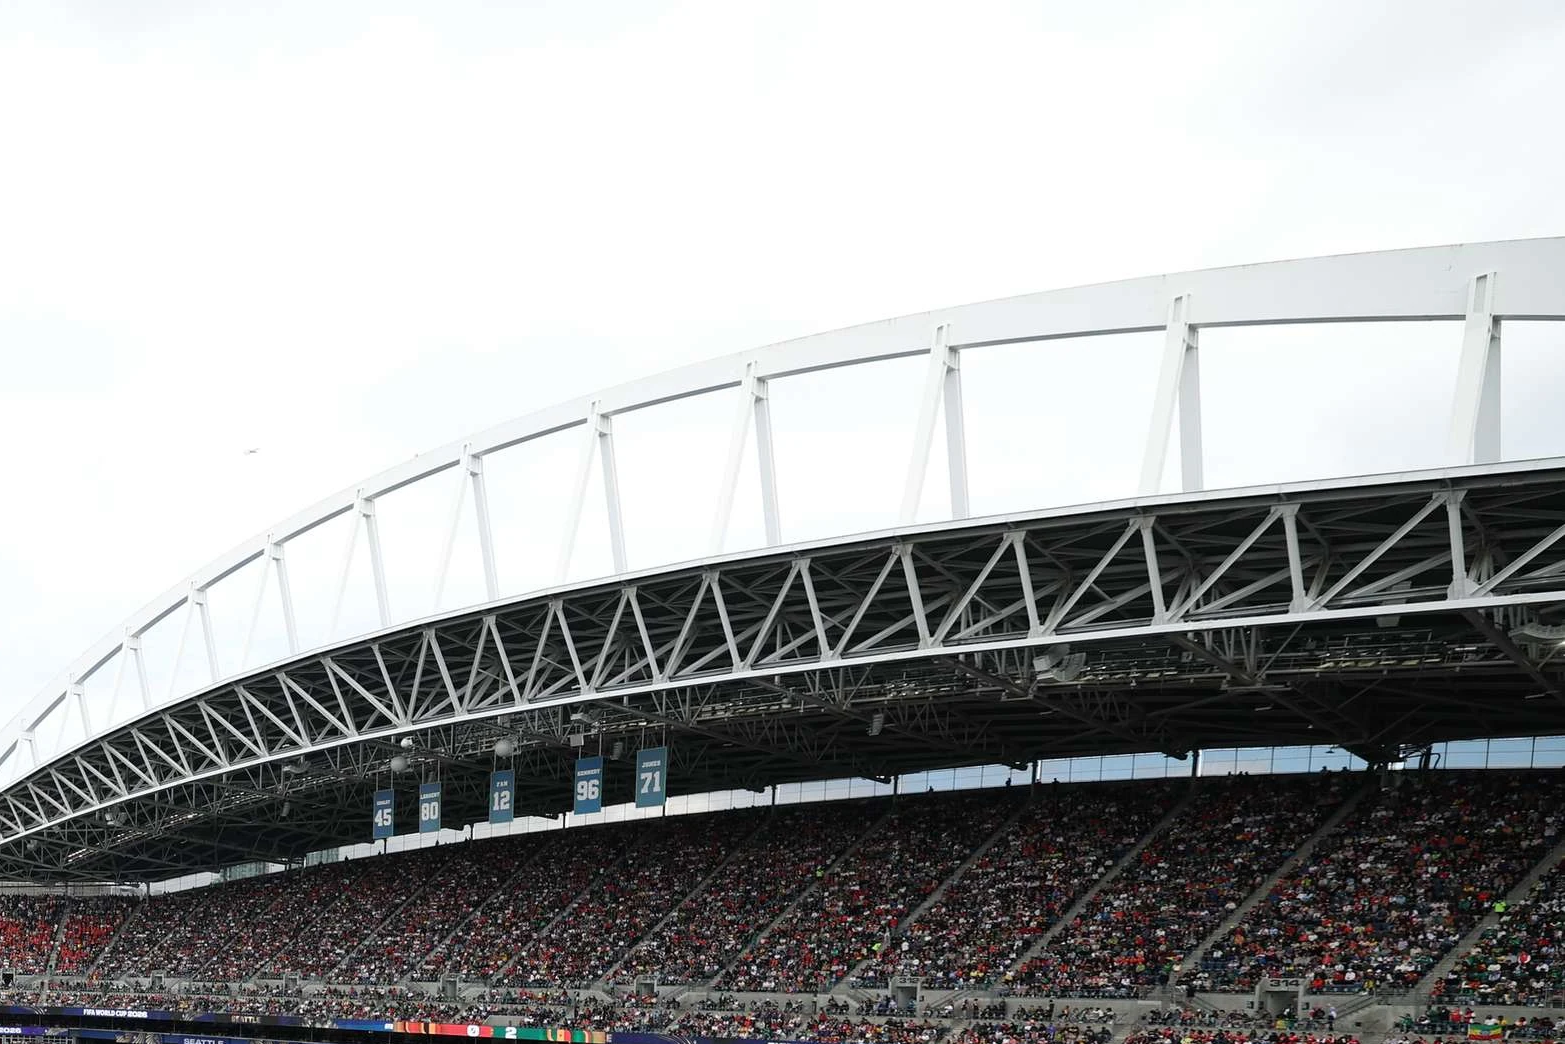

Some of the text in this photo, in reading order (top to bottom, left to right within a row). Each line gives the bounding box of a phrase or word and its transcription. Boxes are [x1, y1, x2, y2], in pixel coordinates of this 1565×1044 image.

[576, 780, 600, 801] 96
[640, 771, 661, 794] 71
[492, 790, 511, 811] 12
[374, 808, 392, 827] 45
[422, 802, 438, 821] 80
[467, 1025, 479, 1037] 0
[505, 1027, 517, 1039] 2
